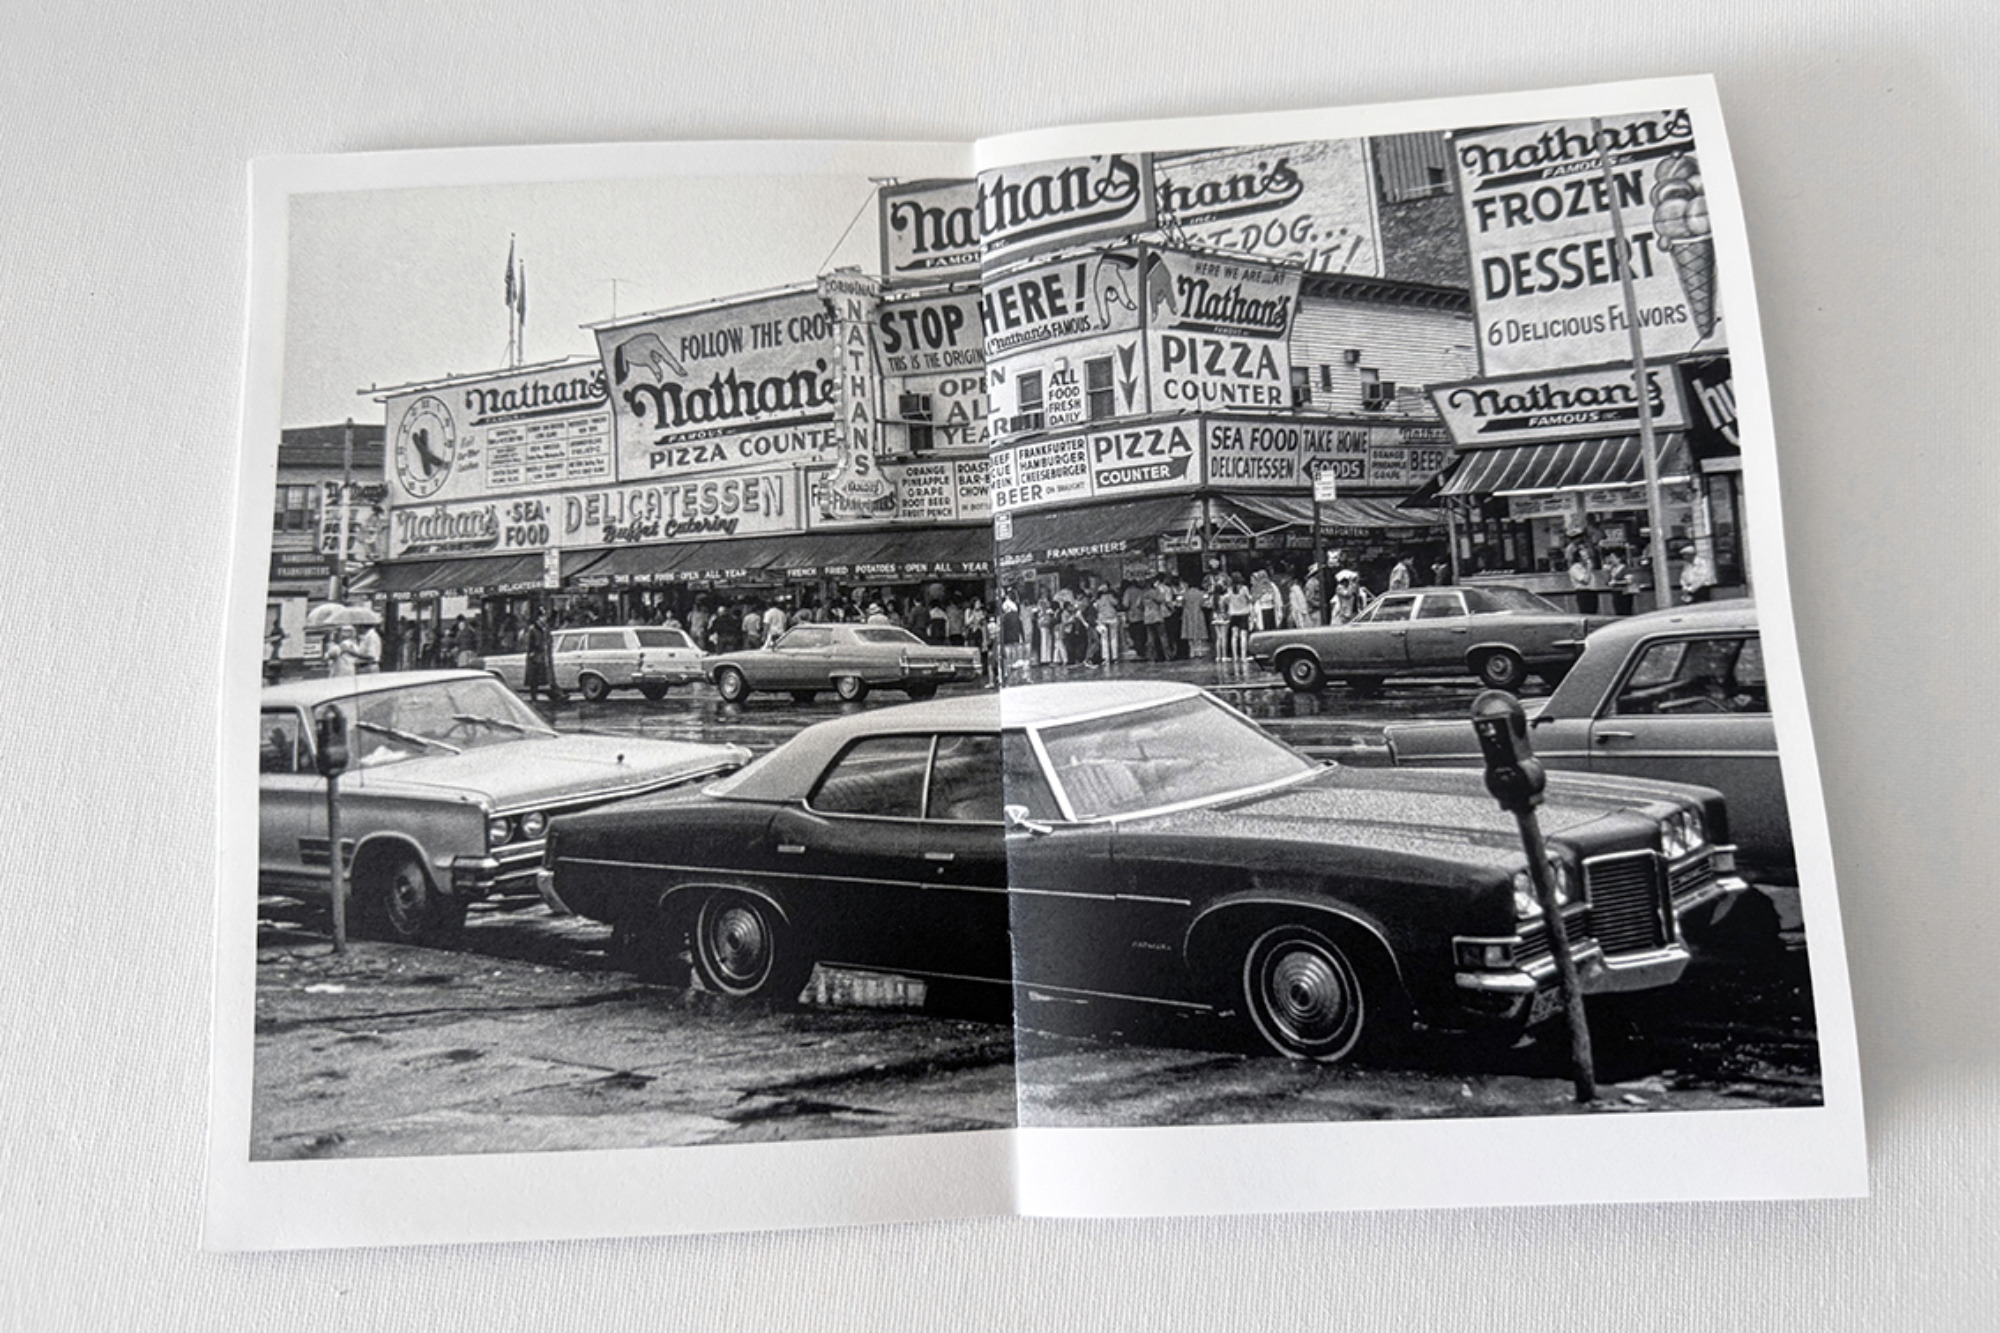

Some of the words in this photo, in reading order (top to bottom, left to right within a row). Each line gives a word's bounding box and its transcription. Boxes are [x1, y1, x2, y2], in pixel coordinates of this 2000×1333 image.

[1472, 169, 1645, 233] FROZEN
[1481, 232, 1655, 301] DESSERT
[880, 304, 964, 354] STOP
[978, 263, 1088, 337] HERE!
[680, 327, 743, 362] FOLLOW
[751, 320, 782, 350] THE
[788, 312, 834, 344] CRO
[1488, 320, 1505, 346] 6
[1506, 314, 1605, 344] DELICIOUS
[1162, 335, 1281, 380] PIZZA
[1050, 369, 1079, 386] ALL
[1050, 386, 1080, 400] FOOD
[1164, 378, 1283, 405] COUNTER
[1050, 398, 1081, 412] FRESH
[1050, 411, 1081, 426] DAILY
[1529, 411, 1600, 427] FAMOUS
[650, 443, 728, 470] PIZZA
[739, 428, 837, 458] COUNTE
[1019, 439, 1085, 460] FRANKFURTER
[1094, 426, 1193, 463] PIZZA
[1211, 426, 1244, 451] SEA
[1250, 428, 1299, 452] FOOD
[1304, 430, 1333, 452] TAKE
[1337, 431, 1368, 453] HOME
[906, 465, 945, 477] ORANGE
[1019, 451, 1085, 471] HAMBURGER
[1211, 456, 1296, 479] DELICATESSEN
[1411, 451, 1443, 471] BEER
[902, 476, 950, 487] PINEAPPLE
[1021, 463, 1087, 484] CHEESEBURGER
[1099, 465, 1170, 485] COUNTER
[907, 487, 944, 498] GRAPE
[928, 497, 951, 507] BEER
[996, 484, 1043, 507] BEER
[512, 501, 545, 523] SEA
[565, 475, 784, 533] DELICATESSEN
[506, 524, 549, 546] FOOD
[664, 515, 739, 538] Catering
[1047, 540, 1127, 559] FRANKFURTERS
[704, 568, 721, 579] ALL
[725, 567, 746, 577] YEAR
[787, 566, 817, 578] FRENCH
[855, 563, 895, 574] POTATOES
[905, 562, 927, 572] OPEN
[934, 561, 951, 572] ALL
[962, 561, 988, 572] YEAR
